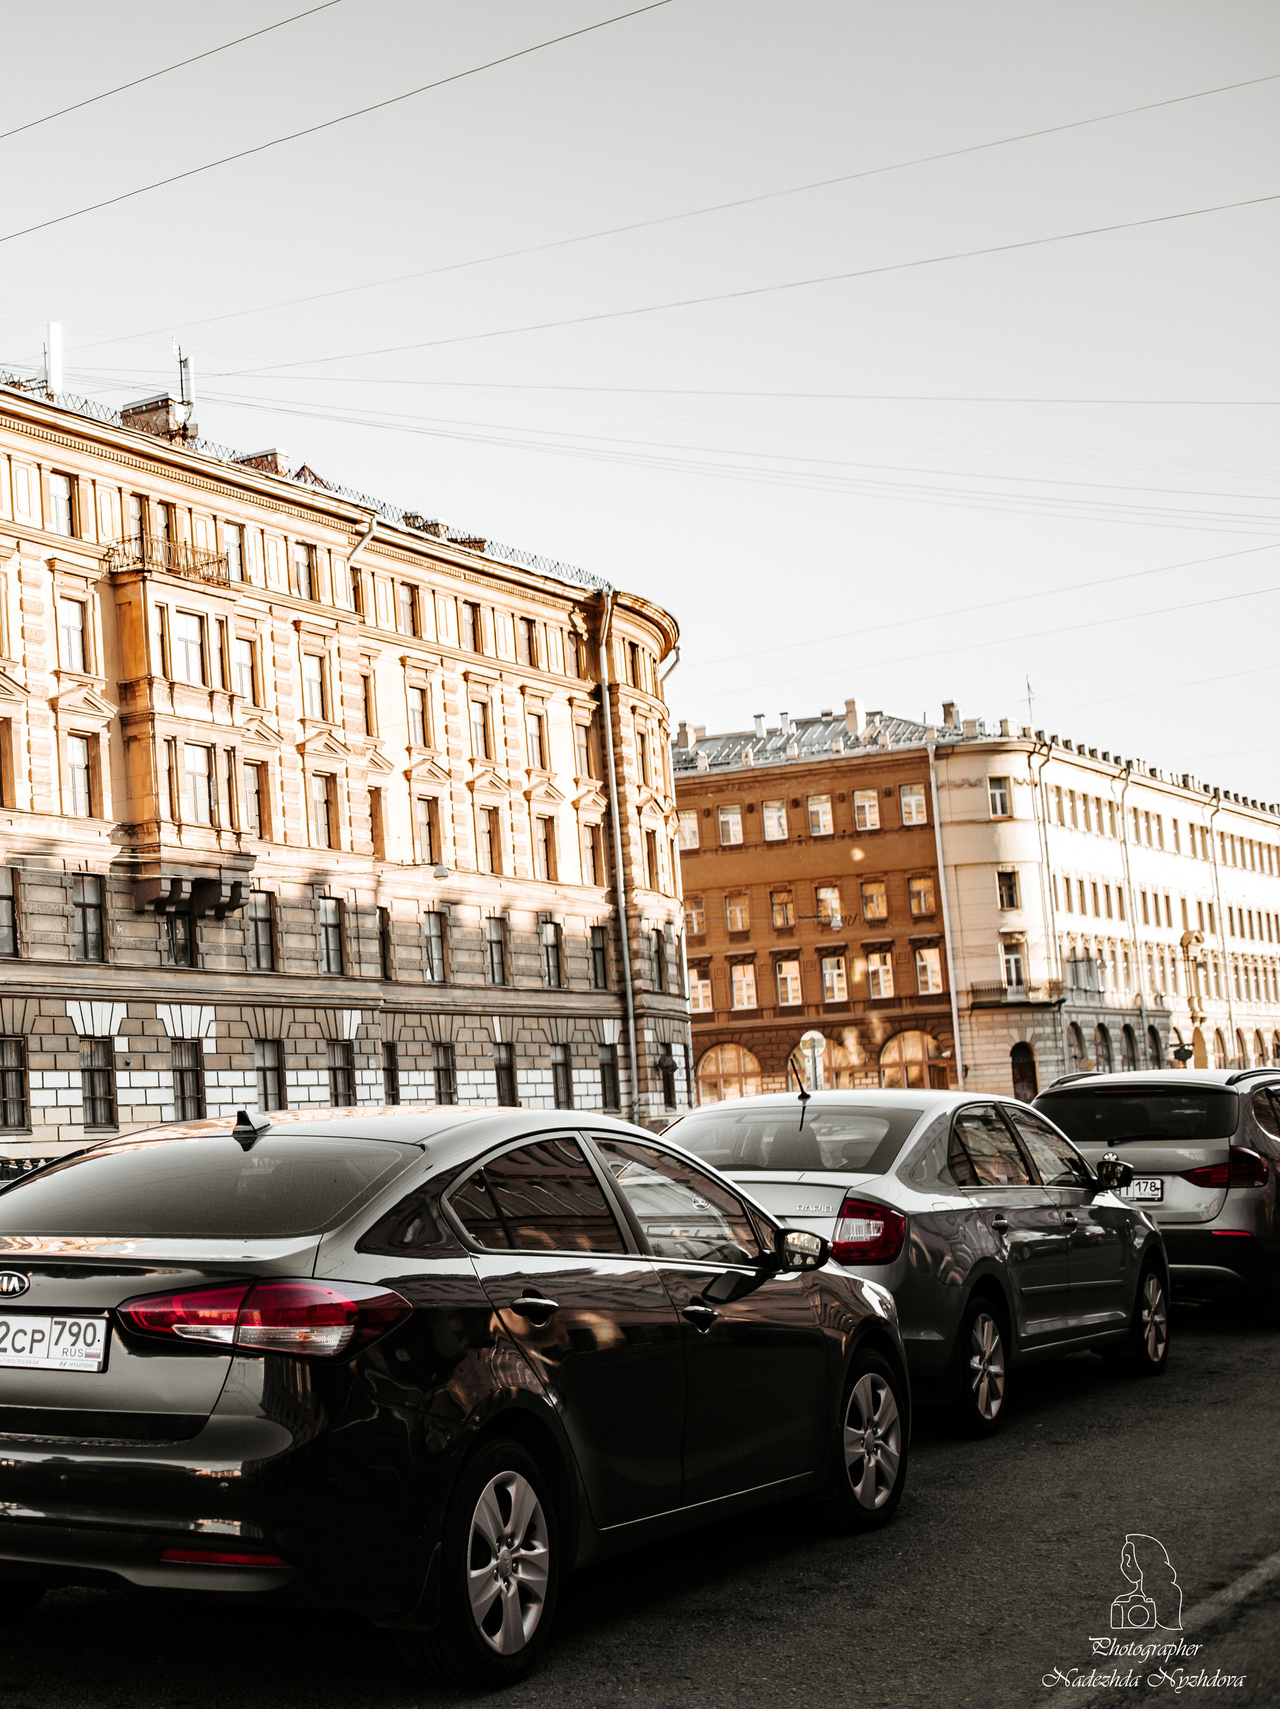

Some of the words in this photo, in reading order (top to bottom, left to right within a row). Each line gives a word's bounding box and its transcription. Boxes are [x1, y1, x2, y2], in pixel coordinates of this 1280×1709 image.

[1135, 1181, 1156, 1192] 178
[796, 1204, 833, 1213] RAPID
[53, 1320, 98, 1348] 790
[61, 1347, 84, 1358] RUS
